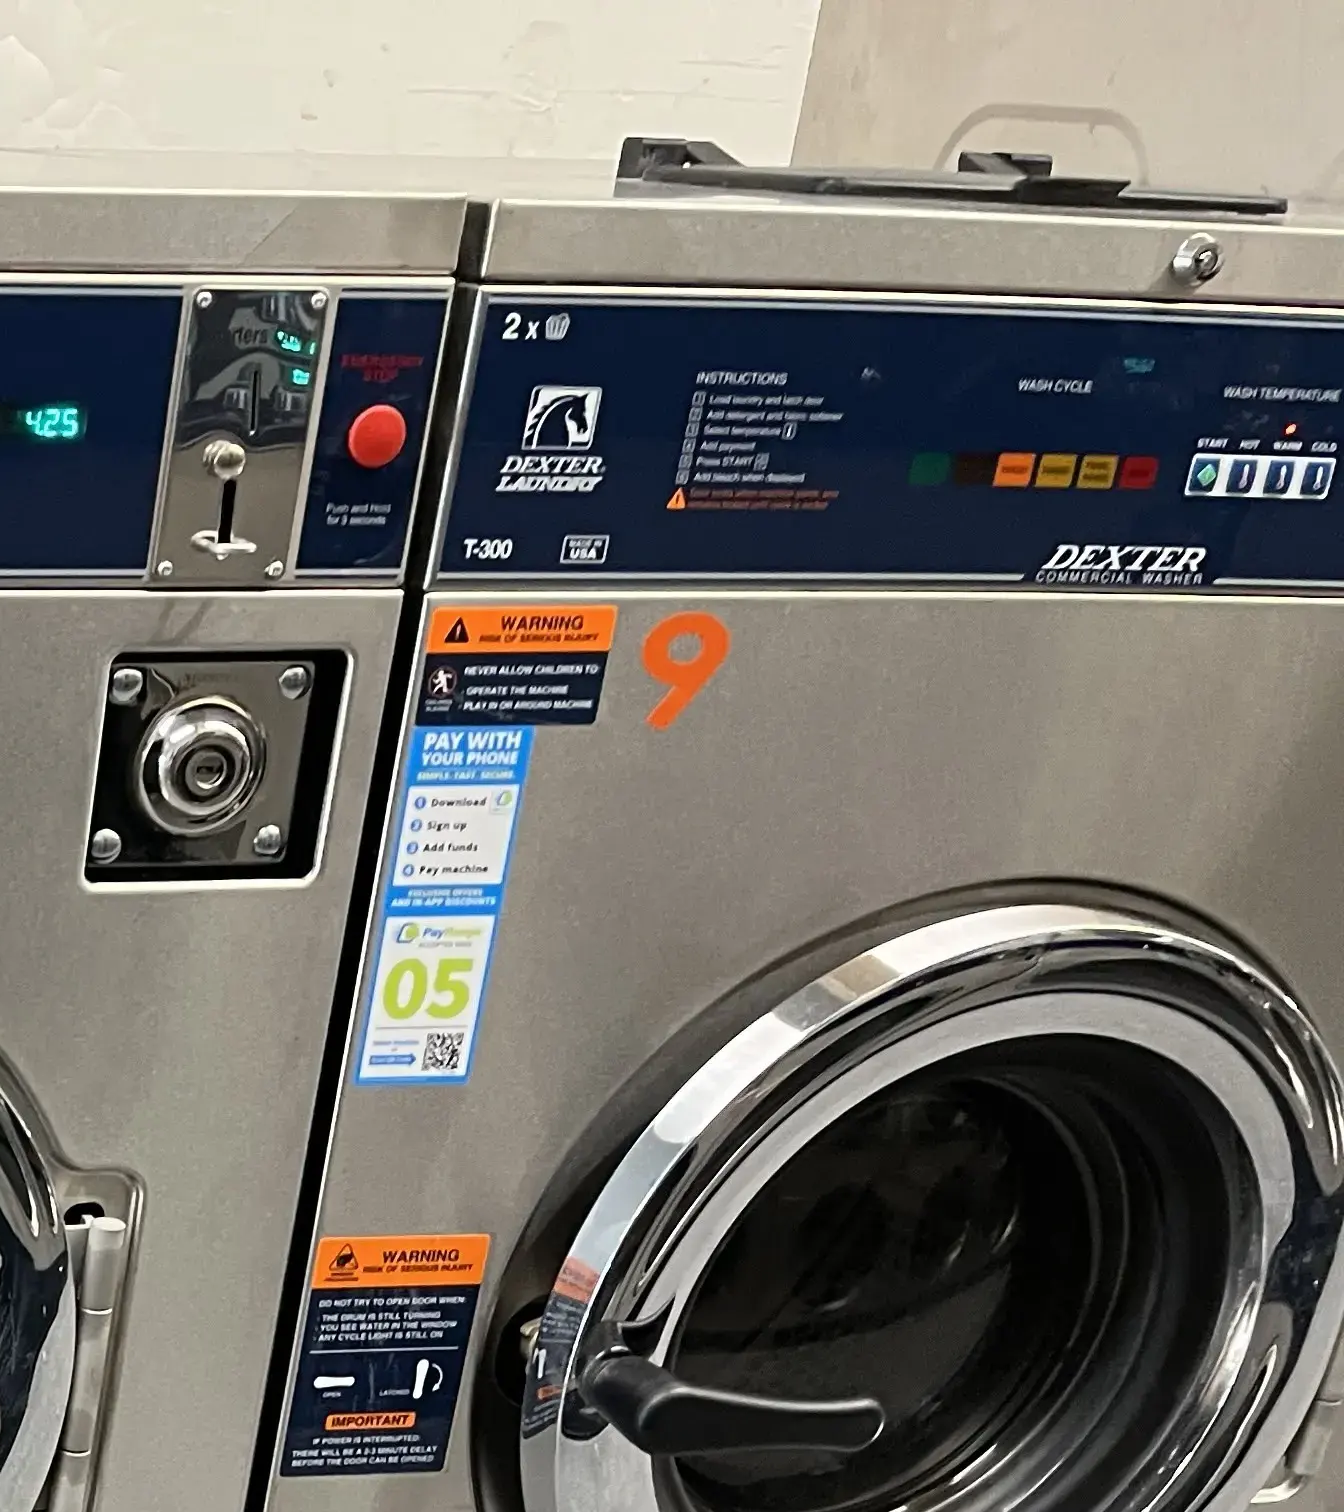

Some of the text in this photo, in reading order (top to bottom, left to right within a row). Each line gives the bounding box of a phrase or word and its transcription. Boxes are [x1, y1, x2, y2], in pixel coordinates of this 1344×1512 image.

[502, 312, 521, 340] 2
[696, 372, 788, 385] INSTRUCTIONS
[1018, 377, 1093, 393] WASH CYCLE
[1224, 386, 1342, 402] WASH TEMPERATURE
[1311, 441, 1337, 452] COLD
[500, 455, 603, 474] DEXTER
[495, 476, 603, 492] LAUNDRY
[463, 538, 513, 560] T-300
[569, 548, 597, 559] USA
[1042, 544, 1207, 573] DEXTER
[1035, 570, 1203, 586] COMMERCIAL WASHER
[501, 615, 584, 631] WARNING
[641, 611, 731, 730] 9
[423, 730, 522, 750] PAY WITH
[421, 751, 518, 766] YOUR PHONE
[431, 797, 487, 807] Download
[427, 821, 467, 832] Sign up
[423, 843, 478, 852] Add funds
[419, 864, 488, 876] Pay machine
[382, 958, 473, 1020] 05
[383, 1249, 459, 1263] WARNING
[331, 1415, 409, 1428] IMPORTANT
